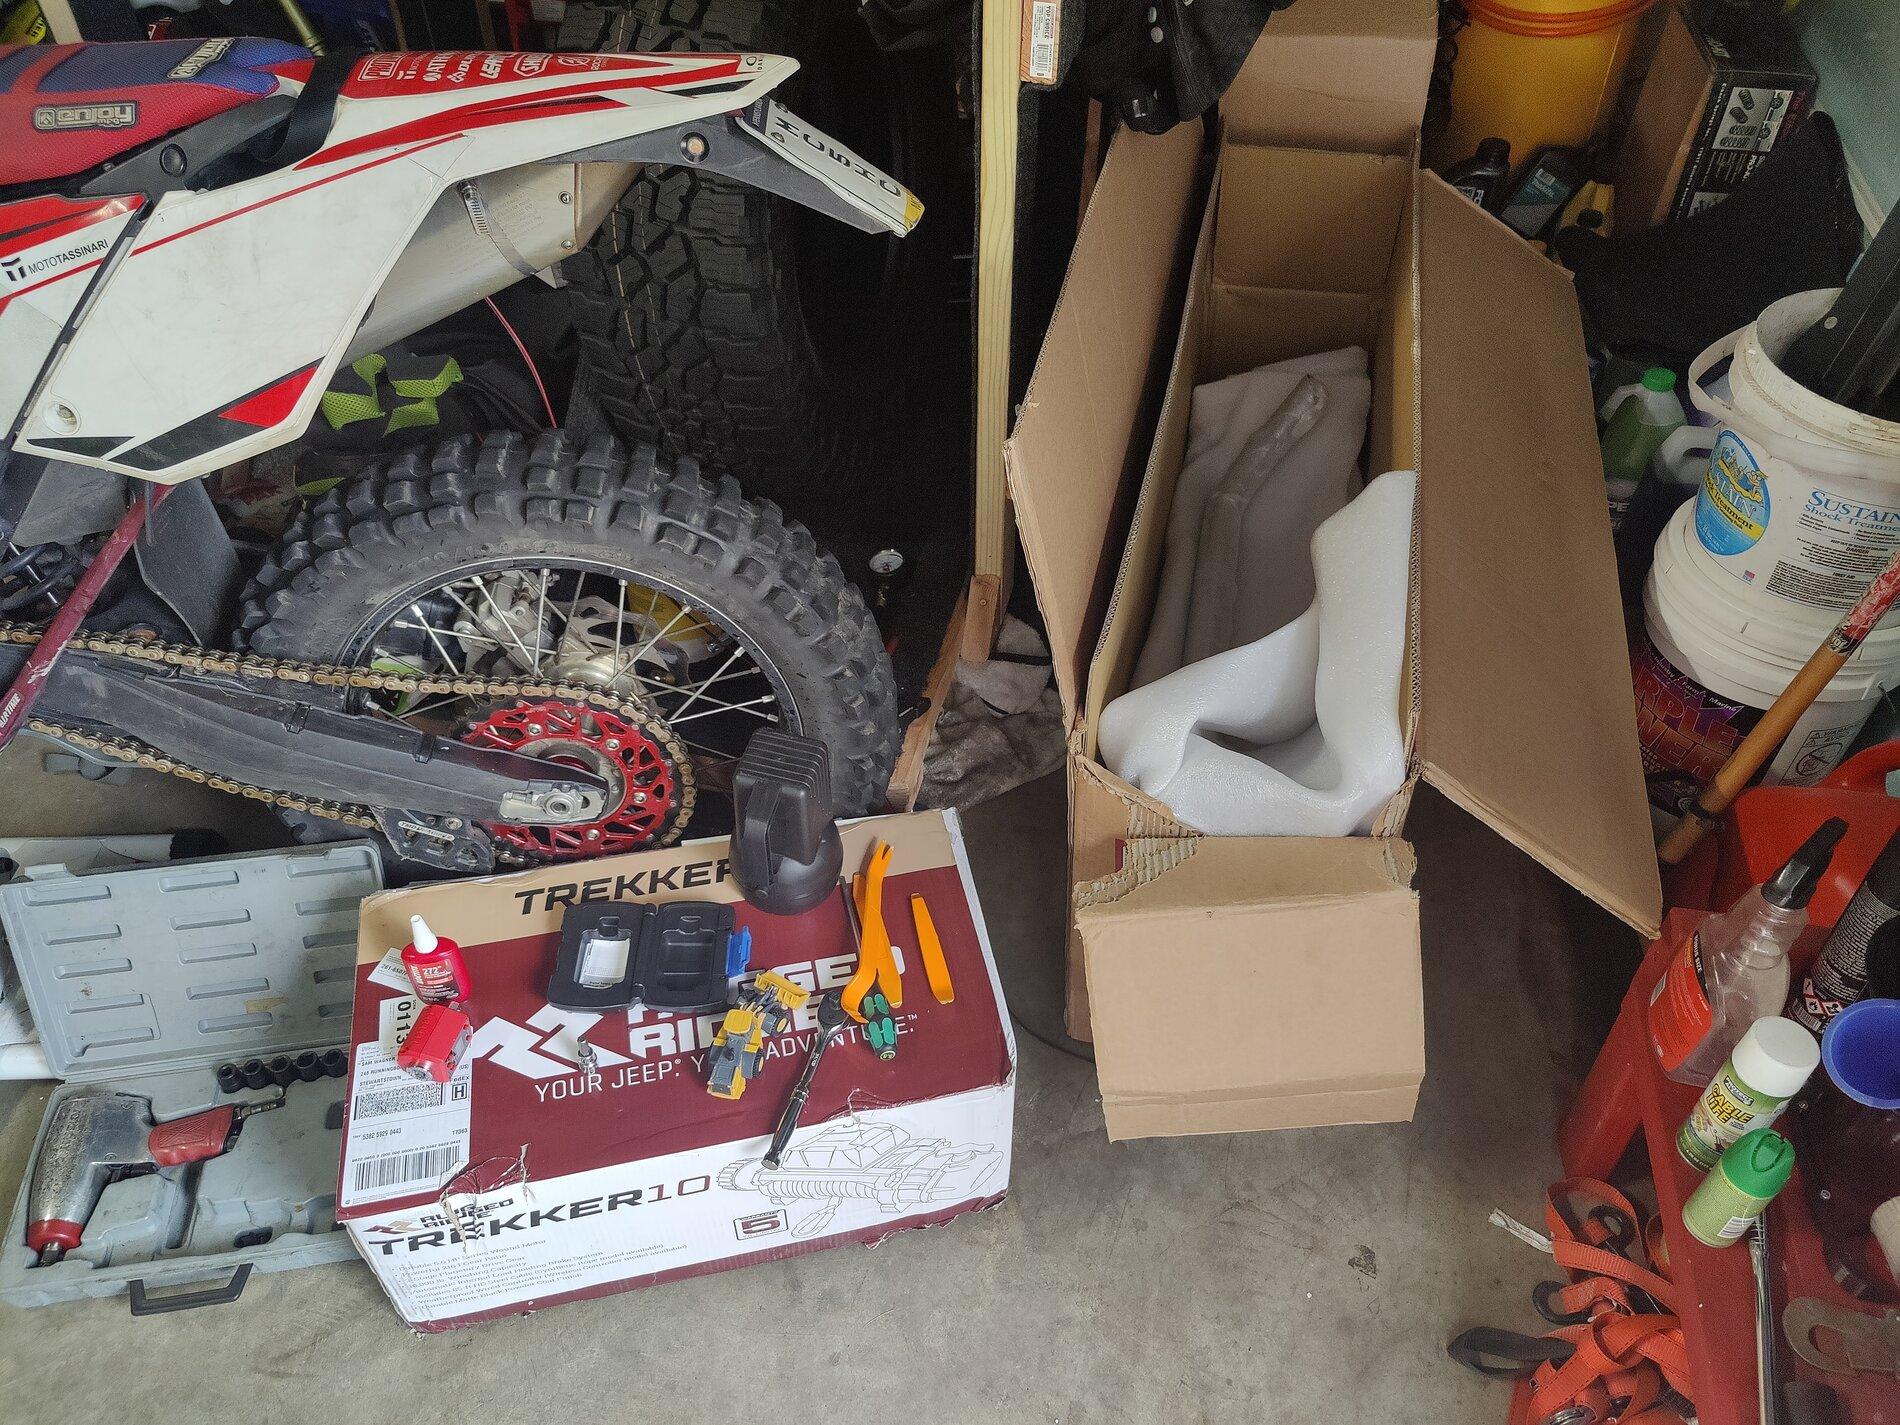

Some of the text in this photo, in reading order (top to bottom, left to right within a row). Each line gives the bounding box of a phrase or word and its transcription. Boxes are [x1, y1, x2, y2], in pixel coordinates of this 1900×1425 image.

[58, 104, 133, 124] enjoy
[28, 239, 109, 274] MOTOTASSINARI
[1804, 504, 1841, 522] Shock
[1846, 546, 1869, 554] DANGER
[1709, 697, 1738, 711] Marine
[454, 1085, 465, 1099] H
[534, 1071, 604, 1102] YOUR
[1712, 1083, 1755, 1124] CABLE
[741, 1214, 781, 1234] 5
